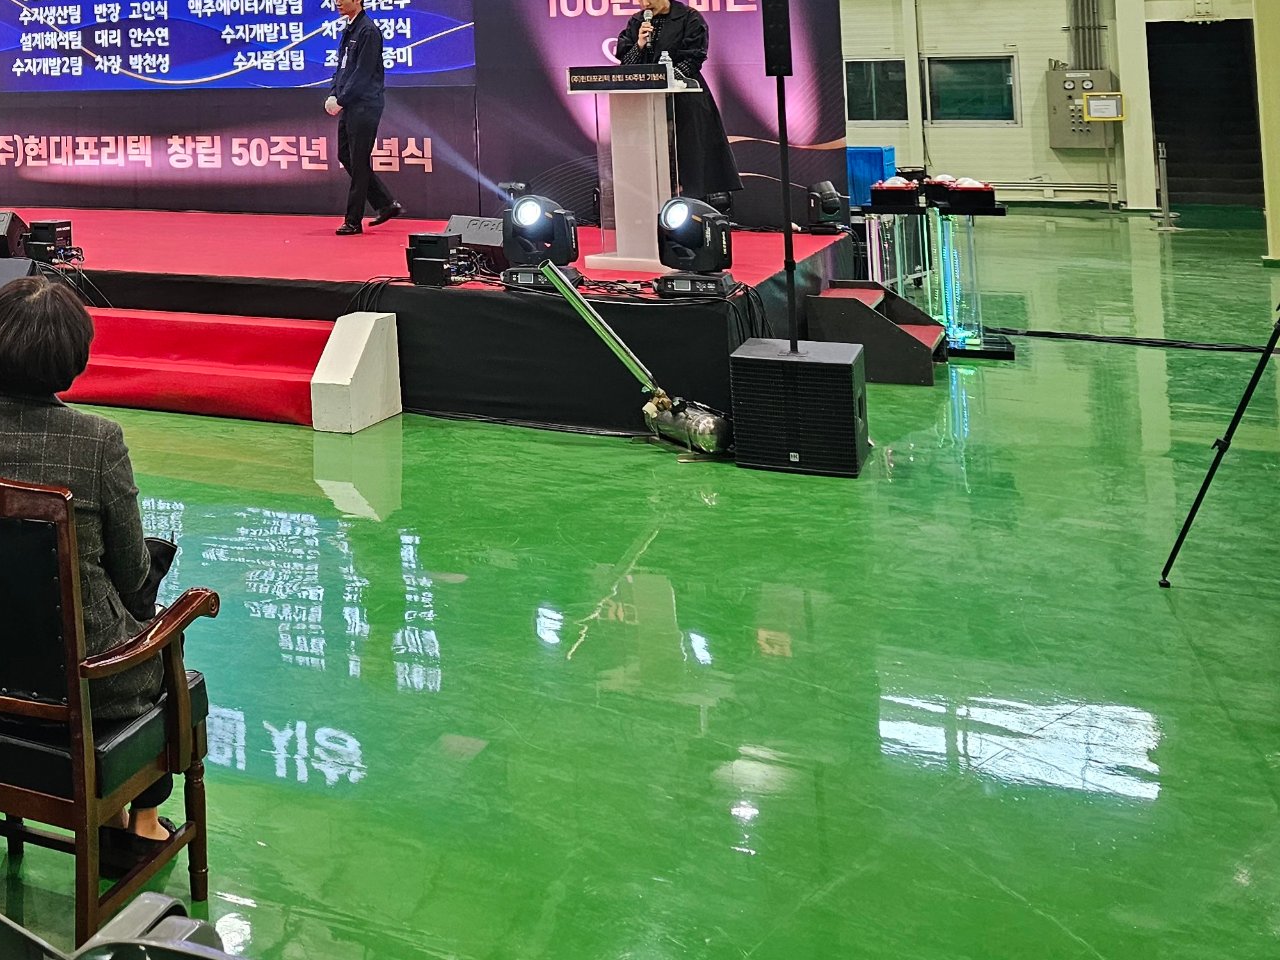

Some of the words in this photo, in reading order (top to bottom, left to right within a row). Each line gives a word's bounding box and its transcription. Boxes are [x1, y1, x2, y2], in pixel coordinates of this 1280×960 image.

[19, 5, 81, 25] 수지생산팀
[94, 3, 121, 23] 반장
[128, 0, 168, 20] 고인식
[20, 31, 82, 51] 설계해석팀
[94, 29, 121, 47] 대리
[128, 27, 169, 47] 안수연
[221, 22, 304, 44] 수지개발1팀
[374, 17, 411, 39] 정식
[11, 56, 82, 76] 수지개발2팀
[94, 55, 121, 73] 차장
[128, 53, 169, 73] 박천성
[233, 50, 305, 71] 수지품질팀
[382, 47, 413, 68] 종미
[167, 135, 221, 168] 창립
[231, 136, 328, 170] 50주년
[340, 137, 433, 173] 념식
